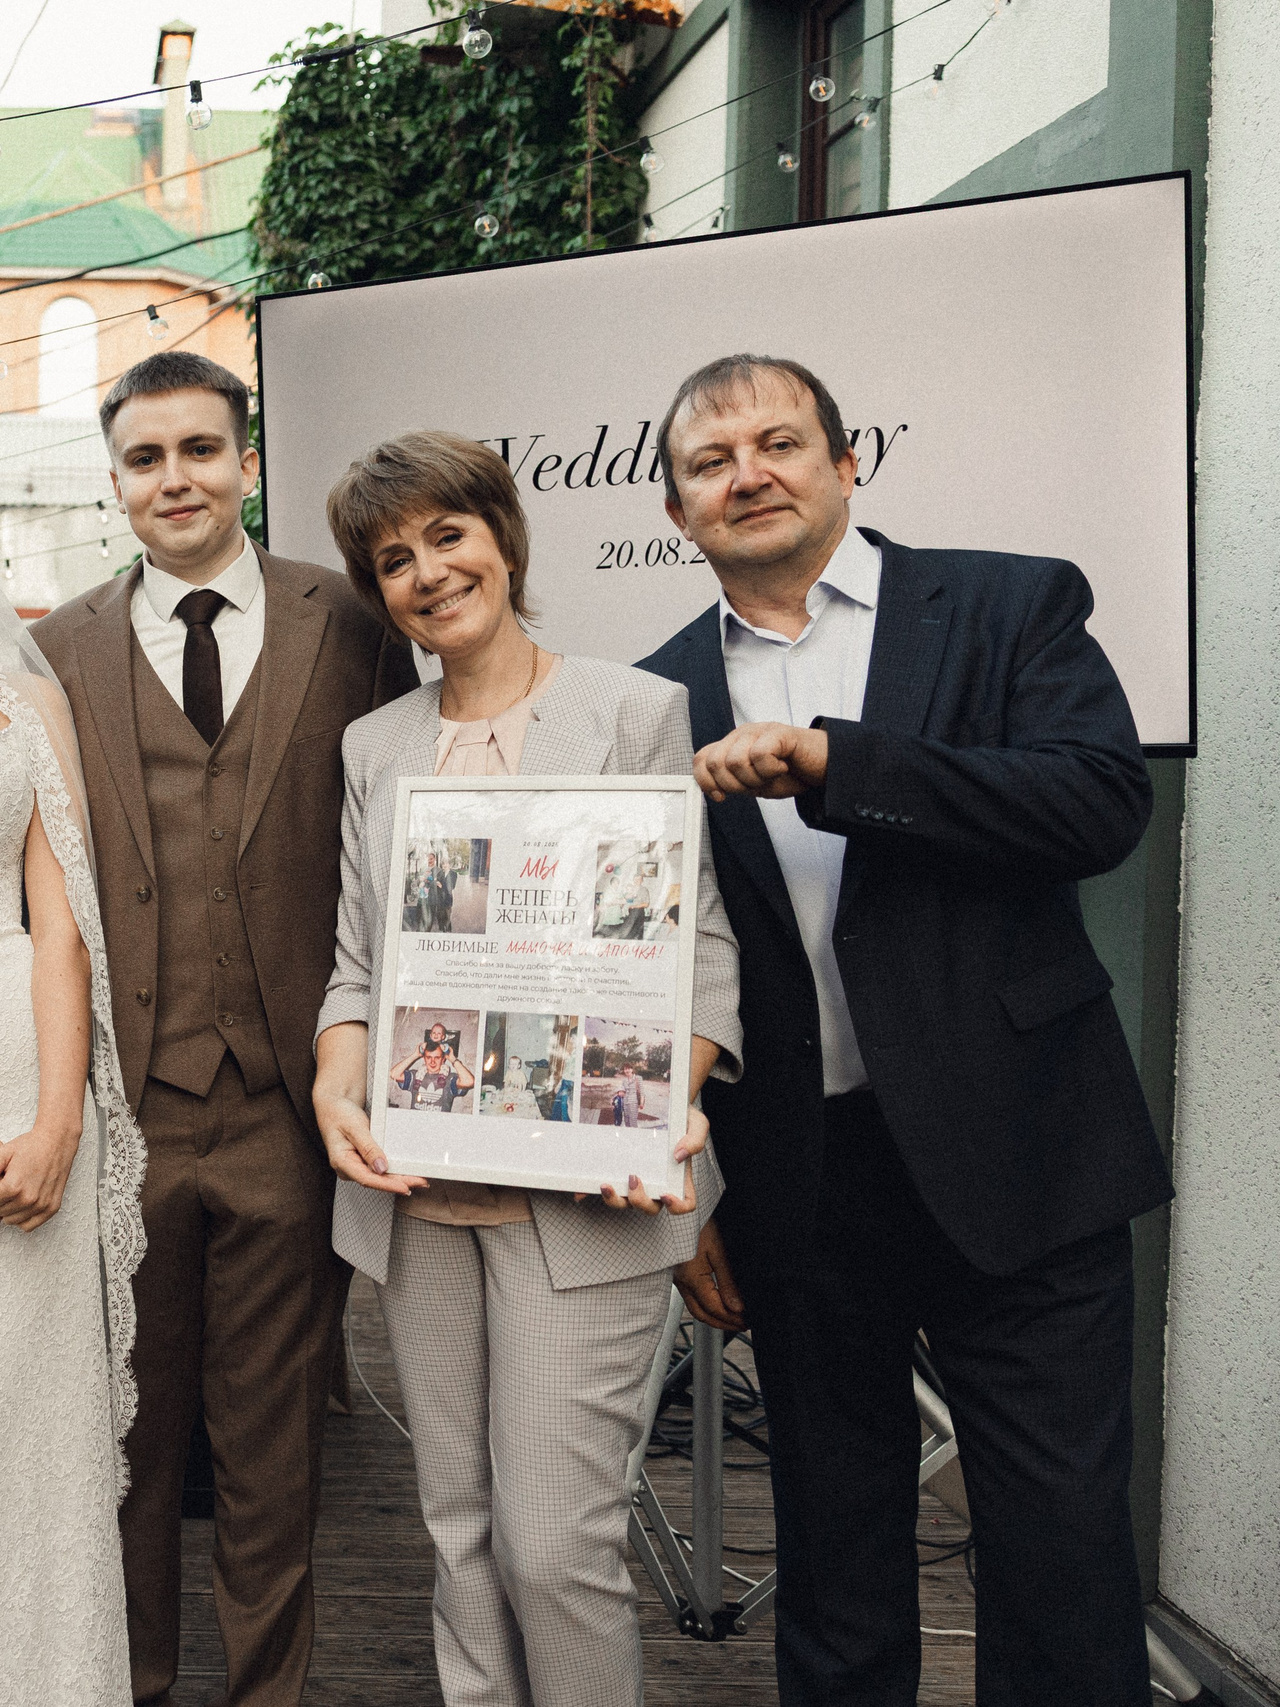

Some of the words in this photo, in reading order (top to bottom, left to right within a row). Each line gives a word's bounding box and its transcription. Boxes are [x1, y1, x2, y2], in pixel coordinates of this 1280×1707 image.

[477, 421, 664, 491] eddi
[596, 537, 706, 569] 20.08.2
[496, 888, 579, 907] ТЕПЕРЬ
[495, 908, 577, 925] ЖЕНАТЫ
[415, 938, 499, 954] ЛЮБИМЫЕ
[445, 959, 478, 968] Спасибо
[505, 963, 525, 971] вашу
